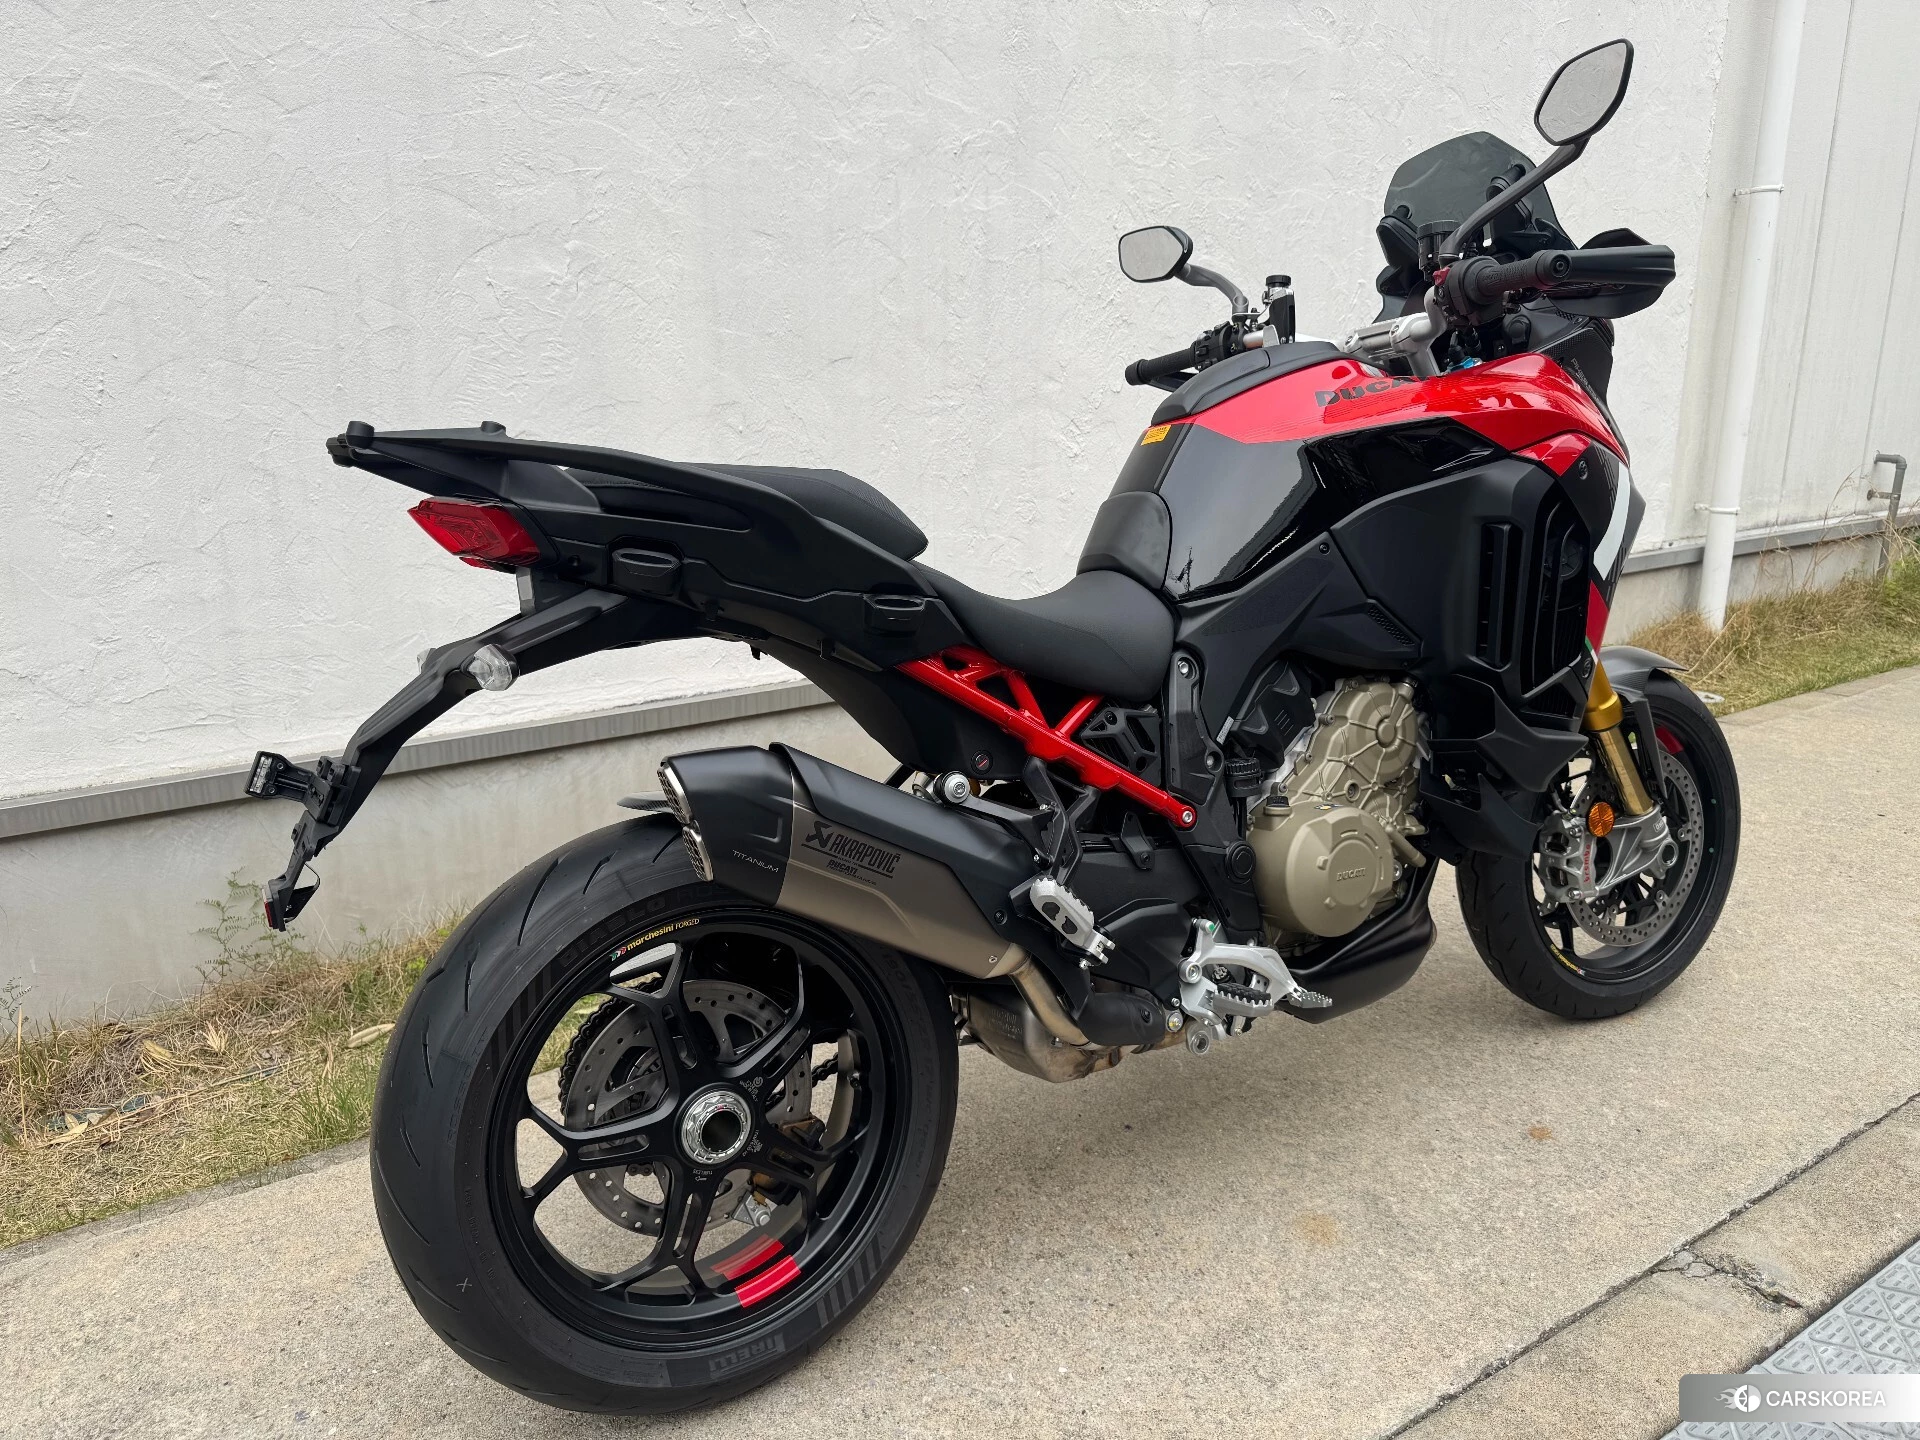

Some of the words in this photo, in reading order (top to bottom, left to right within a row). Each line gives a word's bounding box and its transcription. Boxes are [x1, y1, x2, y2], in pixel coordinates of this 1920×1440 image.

[1314, 376, 1416, 408] DUCA
[732, 850, 779, 873] TITANIUM
[827, 859, 859, 875] DUCATI
[1336, 868, 1366, 881] DUCATI
[627, 924, 674, 951] marchesini
[675, 918, 700, 930] FORGED
[709, 1333, 786, 1378] PIRELLI
